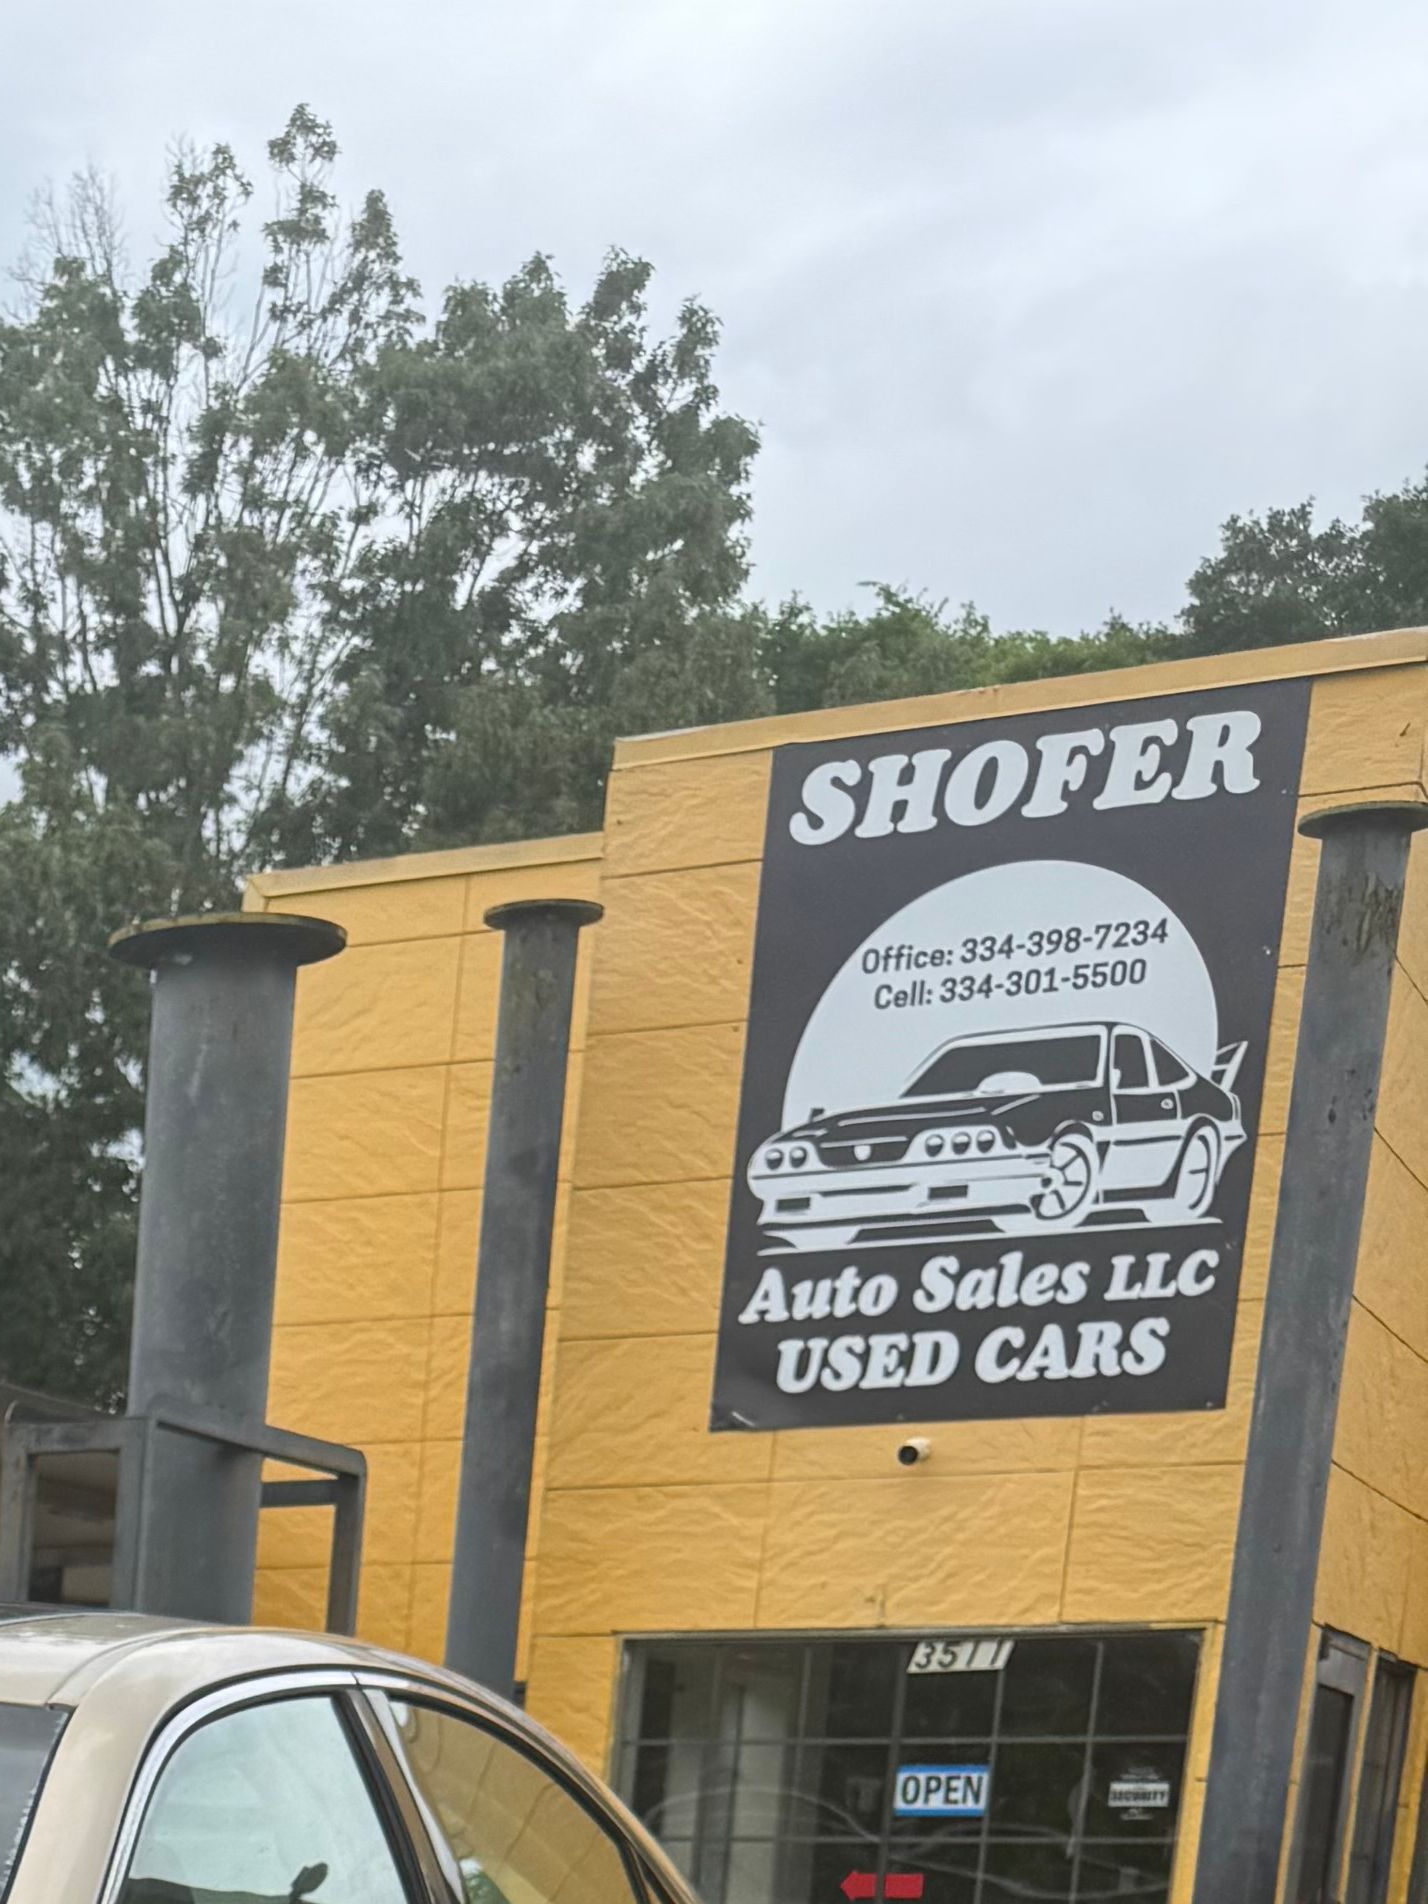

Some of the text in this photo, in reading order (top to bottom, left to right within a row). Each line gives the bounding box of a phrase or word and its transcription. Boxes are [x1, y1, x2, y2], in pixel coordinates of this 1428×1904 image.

[789, 710, 1262, 846] SHOFER
[861, 918, 1169, 974] Office: 334-398-7234
[873, 958, 1148, 1010] Cell: 334-301-5500
[738, 1248, 1220, 1324] Auto Sales LLC
[775, 1317, 1171, 1394] USED CARS
[914, 1641, 1005, 1669] 3511
[900, 1775, 983, 1806] OPEN
